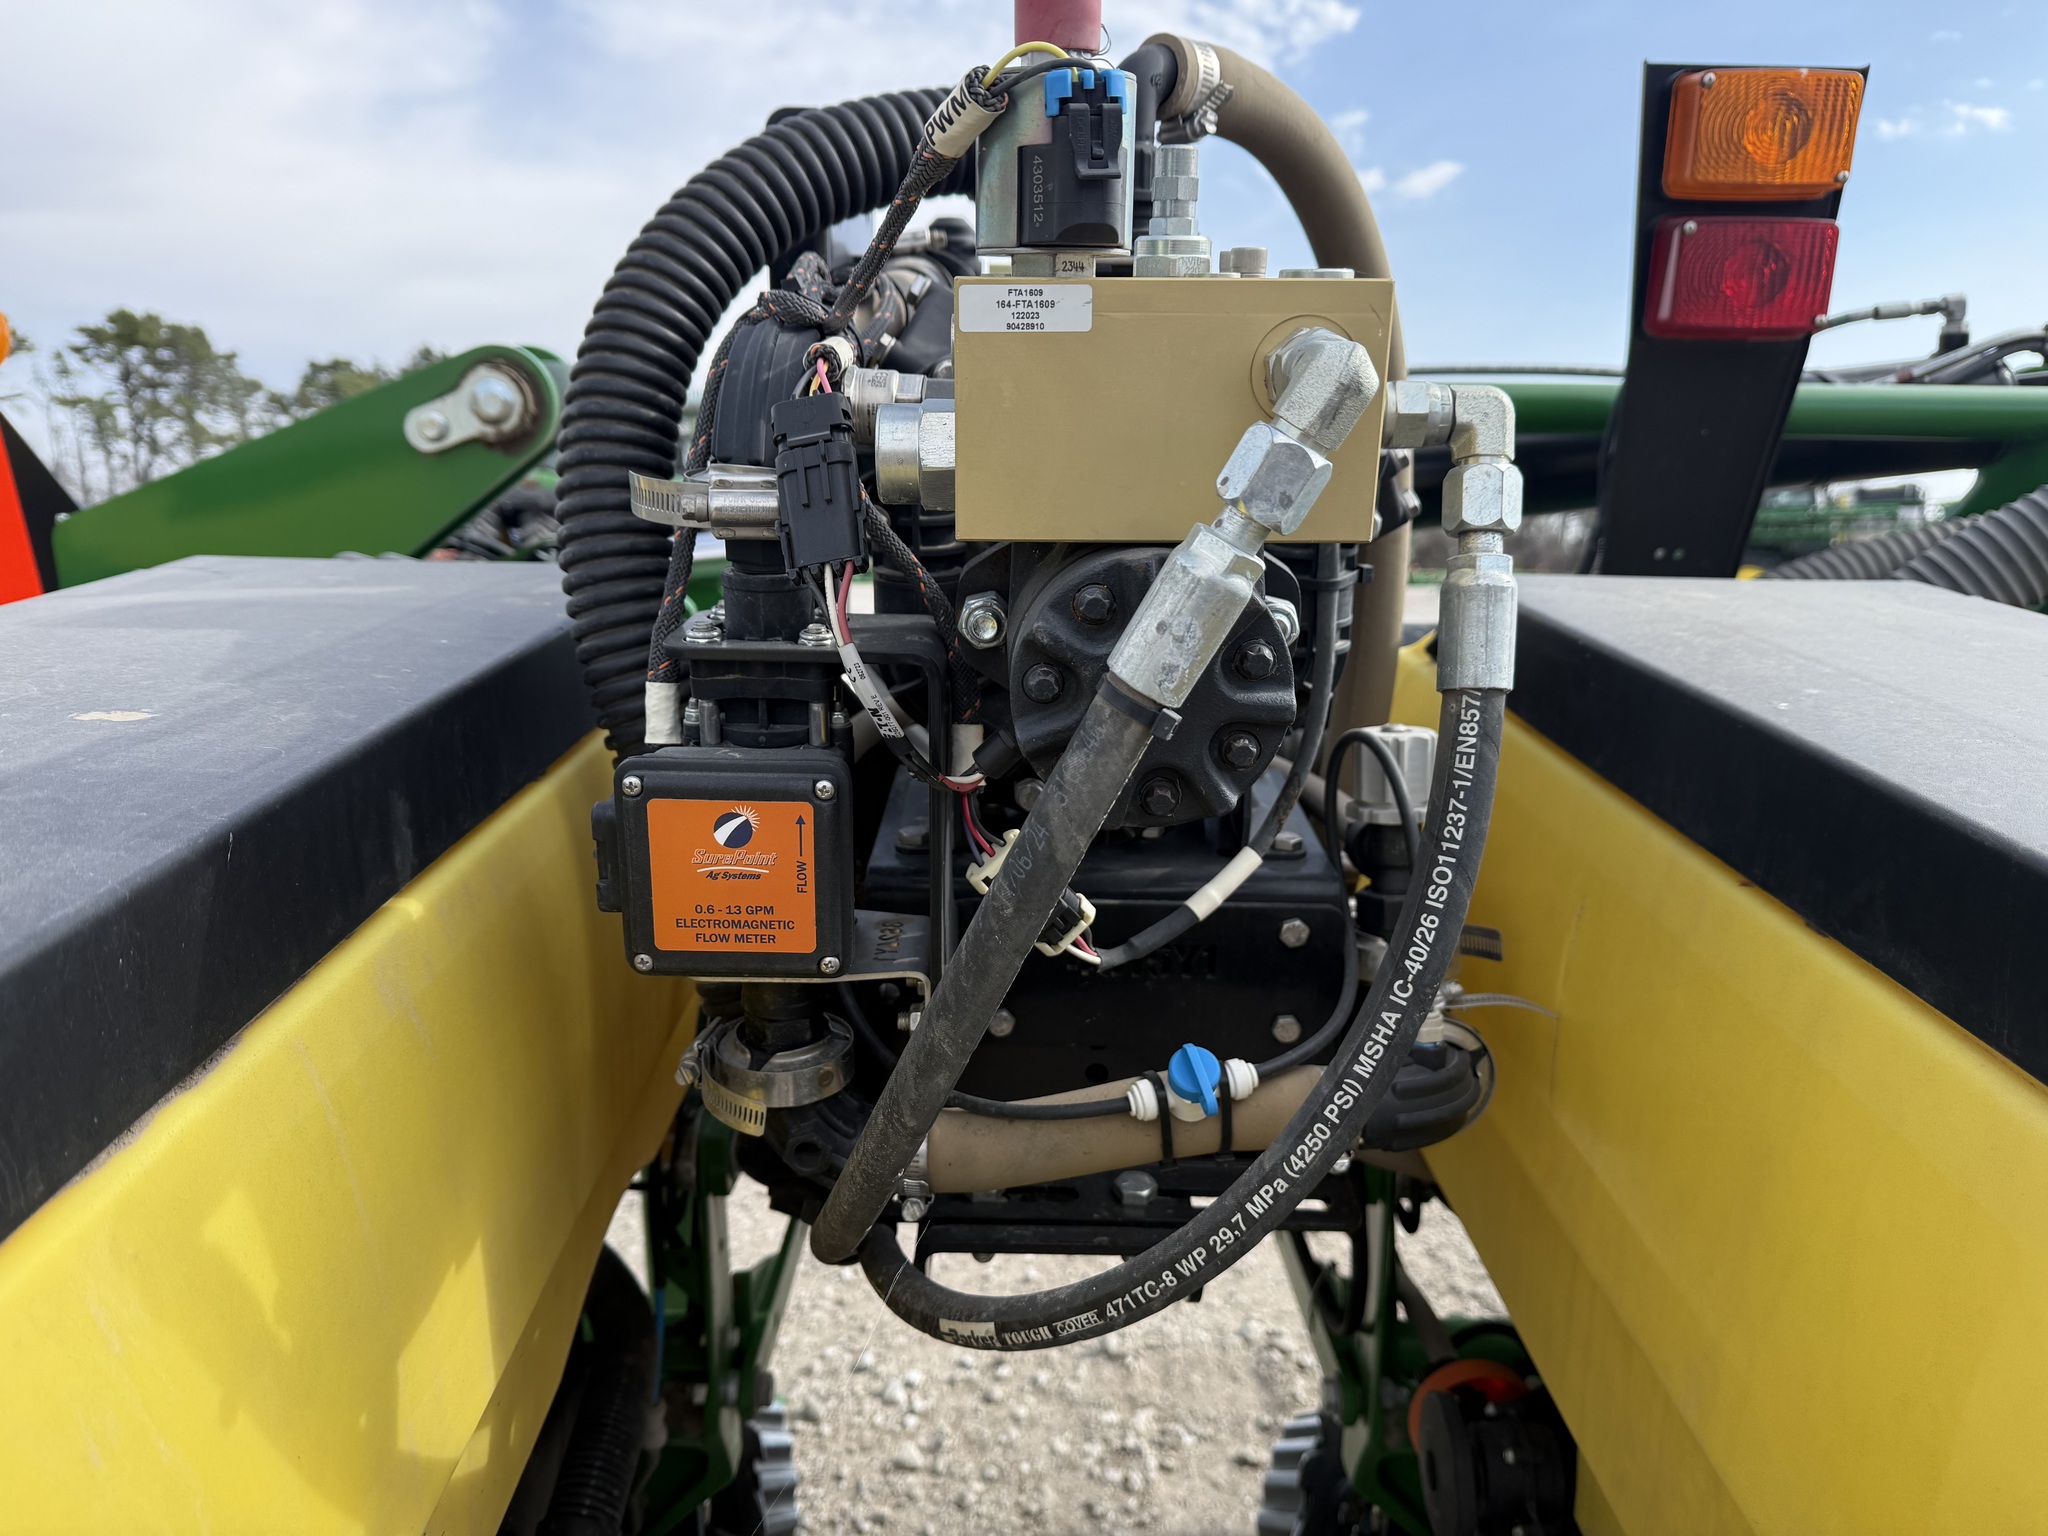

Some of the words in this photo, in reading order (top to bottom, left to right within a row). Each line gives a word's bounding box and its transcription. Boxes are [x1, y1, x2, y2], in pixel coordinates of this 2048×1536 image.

[925, 83, 972, 147] PWM
[1062, 260, 1085, 272] 2344
[1008, 289, 1044, 297] FTA1609
[996, 300, 1056, 309] 164-FTA1609
[1011, 312, 1040, 320] 122023
[1006, 323, 1045, 331] 90428910
[691, 848, 778, 866] SurePoint
[706, 871, 720, 881] Ag
[721, 871, 762, 881] Systems
[796, 860, 808, 894] FLOW
[695, 904, 715, 915] 0.6
[725, 905, 742, 915] 13
[745, 905, 774, 915] GPM
[675, 918, 796, 930] ELECTROMAGNETIC
[695, 933, 731, 943] FLOW
[734, 933, 777, 944] METER
[1002, 1325, 1053, 1346] TOUGH
[1055, 1310, 1101, 1336] COVER
[1106, 1270, 1178, 1318] 471TC-8
[1175, 1246, 1207, 1278] WP
[1208, 1212, 1247, 1254] 29,7
[1244, 1177, 1289, 1219] MPa
[1282, 1122, 1331, 1178] (4250
[1323, 1078, 1364, 1124] PSI)
[1352, 1009, 1402, 1079] MSHA
[1389, 912, 1439, 1006] IC-40/26
